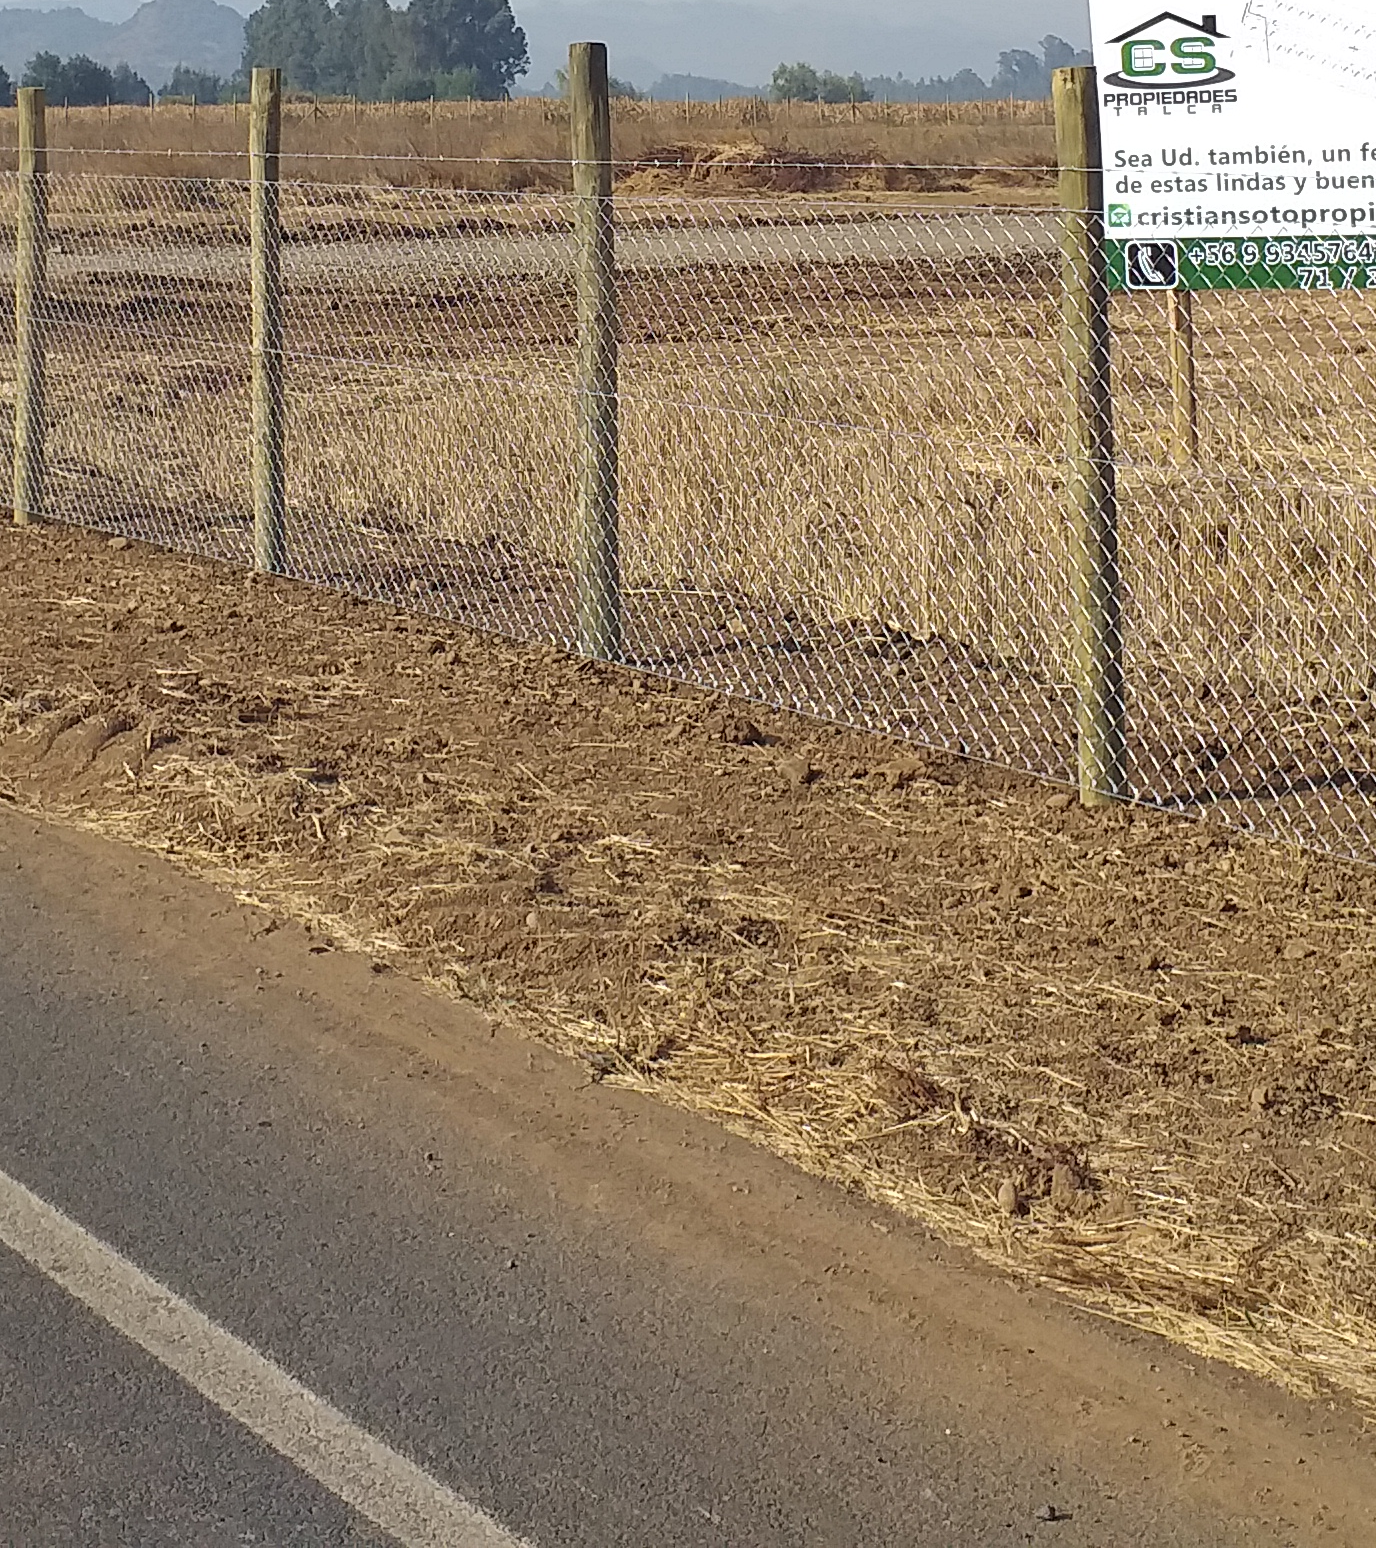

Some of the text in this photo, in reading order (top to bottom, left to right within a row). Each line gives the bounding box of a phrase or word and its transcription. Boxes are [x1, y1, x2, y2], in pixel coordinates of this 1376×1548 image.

[1121, 37, 1216, 77] CS
[1103, 89, 1238, 107] PROPIEDADES
[1114, 150, 1153, 168] Sea
[1162, 147, 1200, 167] Ud.
[1208, 144, 1312, 166] también,
[1322, 147, 1351, 163] un
[1115, 175, 1143, 194] de
[1150, 174, 1208, 193] estas
[1216, 172, 1286, 192] lindas
[1294, 176, 1307, 195] y
[1242, 242, 1259, 266] 9
[1298, 267, 1333, 289] 71
